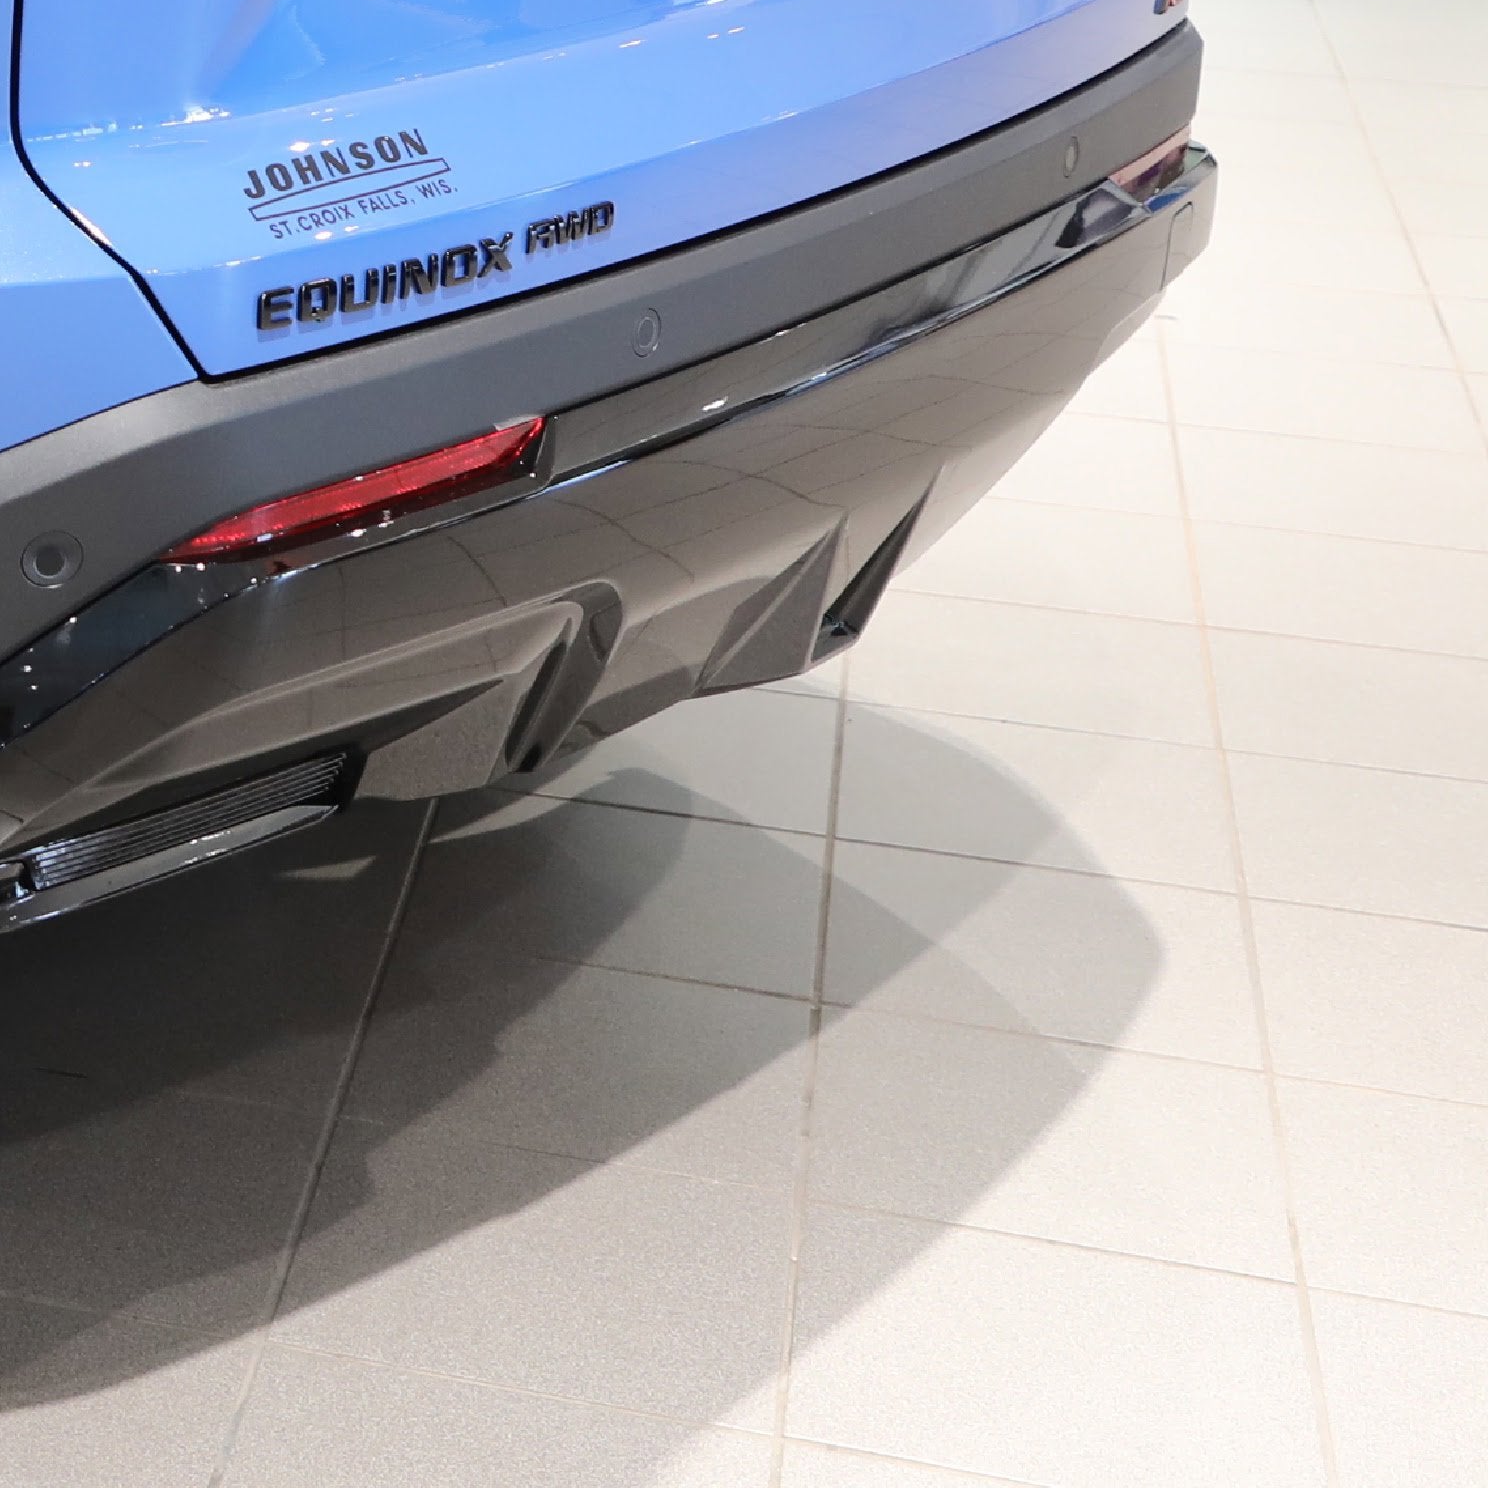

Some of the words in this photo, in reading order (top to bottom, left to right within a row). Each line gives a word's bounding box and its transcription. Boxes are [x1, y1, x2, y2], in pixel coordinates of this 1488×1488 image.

[243, 128, 429, 200] JOHNSON
[415, 179, 458, 201] WIS.
[257, 231, 514, 331] EQUINOX
[525, 200, 616, 256] AWD
